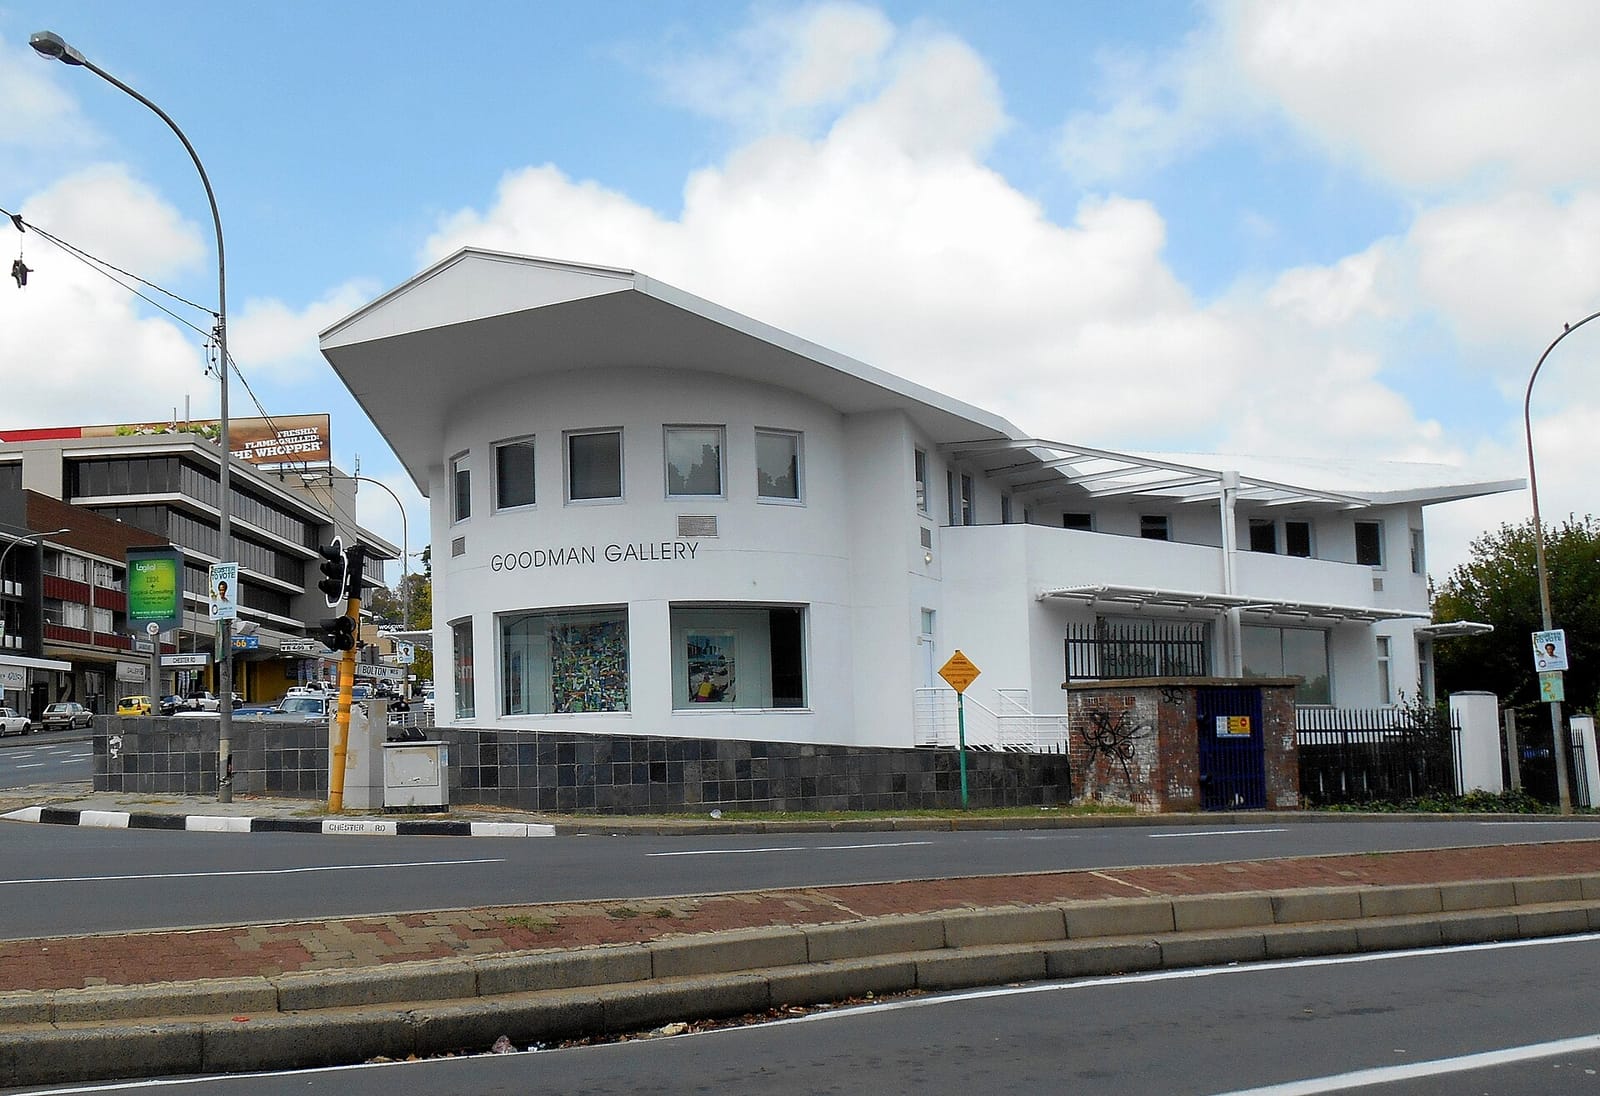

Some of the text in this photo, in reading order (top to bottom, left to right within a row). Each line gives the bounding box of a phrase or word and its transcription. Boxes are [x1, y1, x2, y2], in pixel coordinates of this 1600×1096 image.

[277, 427, 318, 438] FRESHLY
[491, 542, 699, 572] GOODMAN GALLERY
[219, 571, 236, 579] VOTE
[362, 665, 387, 677] BOLTON
[328, 823, 386, 832] CHESTER RD
